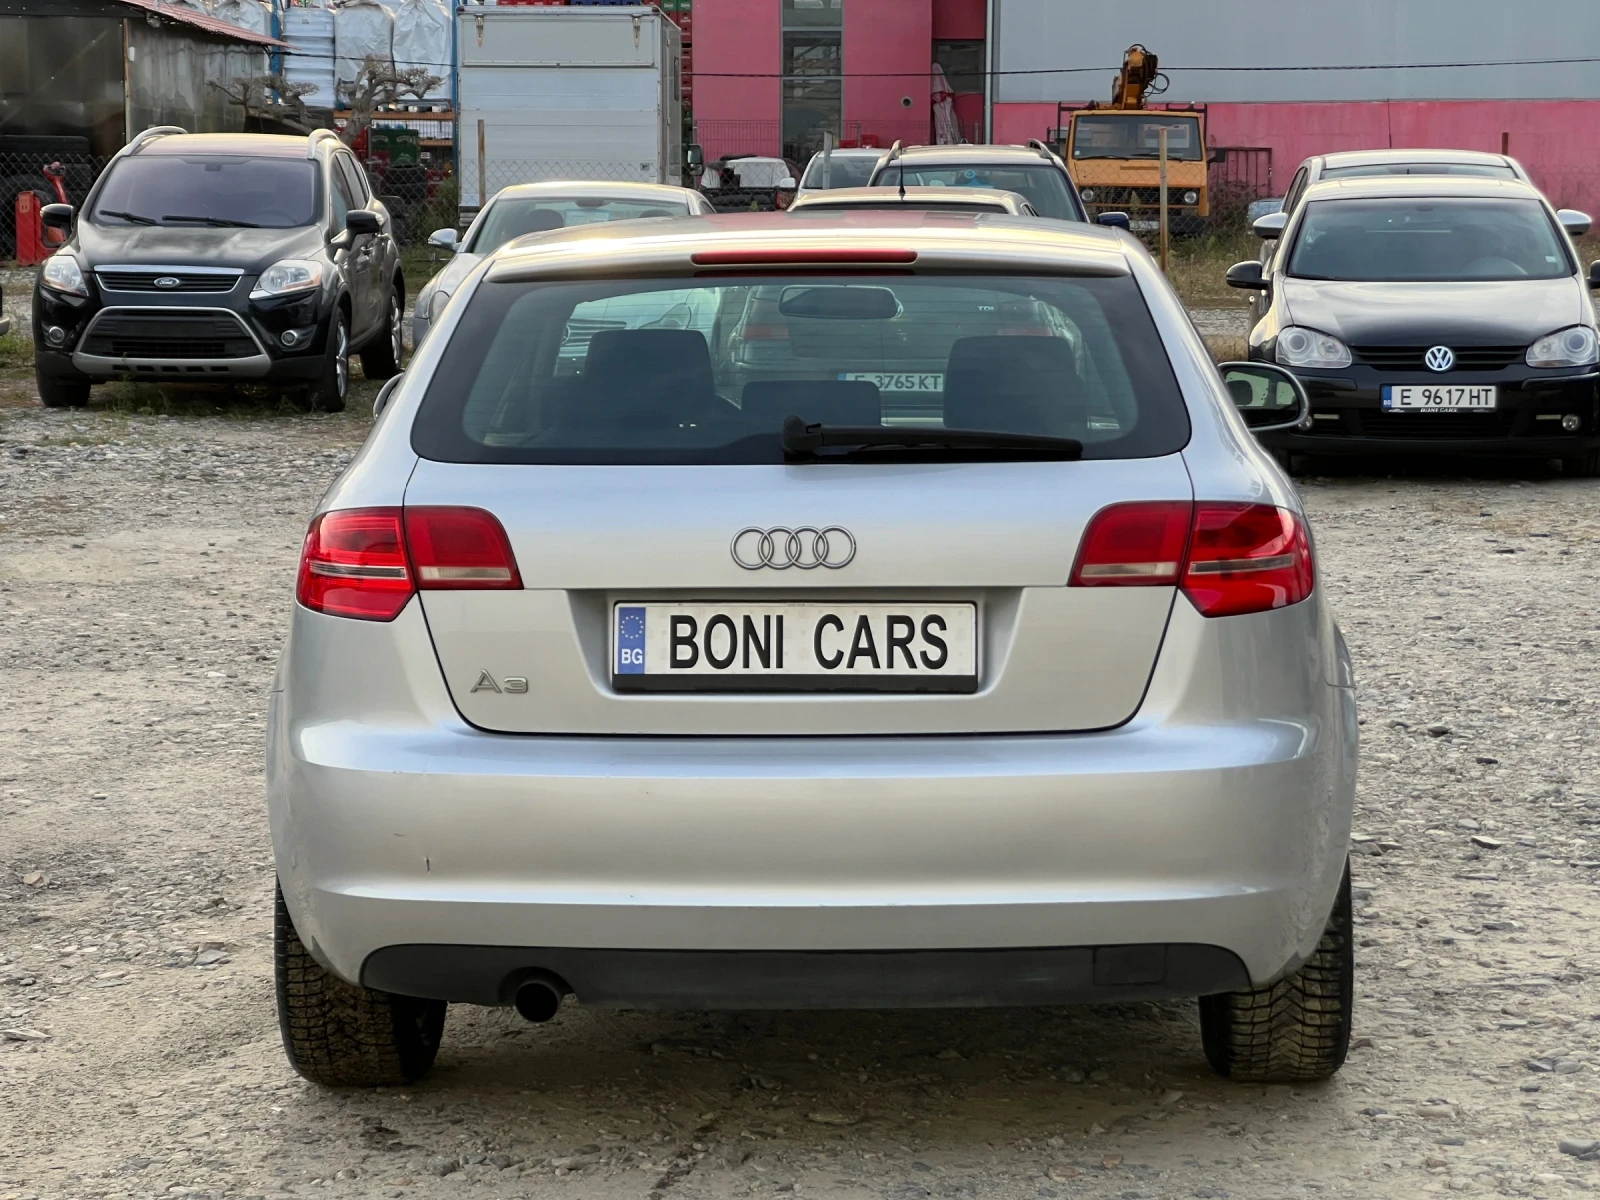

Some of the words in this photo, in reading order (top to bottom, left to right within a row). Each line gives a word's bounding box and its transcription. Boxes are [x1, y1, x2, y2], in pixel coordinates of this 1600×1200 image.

[918, 375, 942, 390] KT
[1400, 388, 1412, 406] E
[1421, 388, 1465, 406] 9617
[1469, 388, 1492, 406] HT
[669, 613, 784, 669] BONI
[813, 613, 949, 670] CARS
[620, 648, 643, 665] BG
[469, 668, 529, 694] A3
